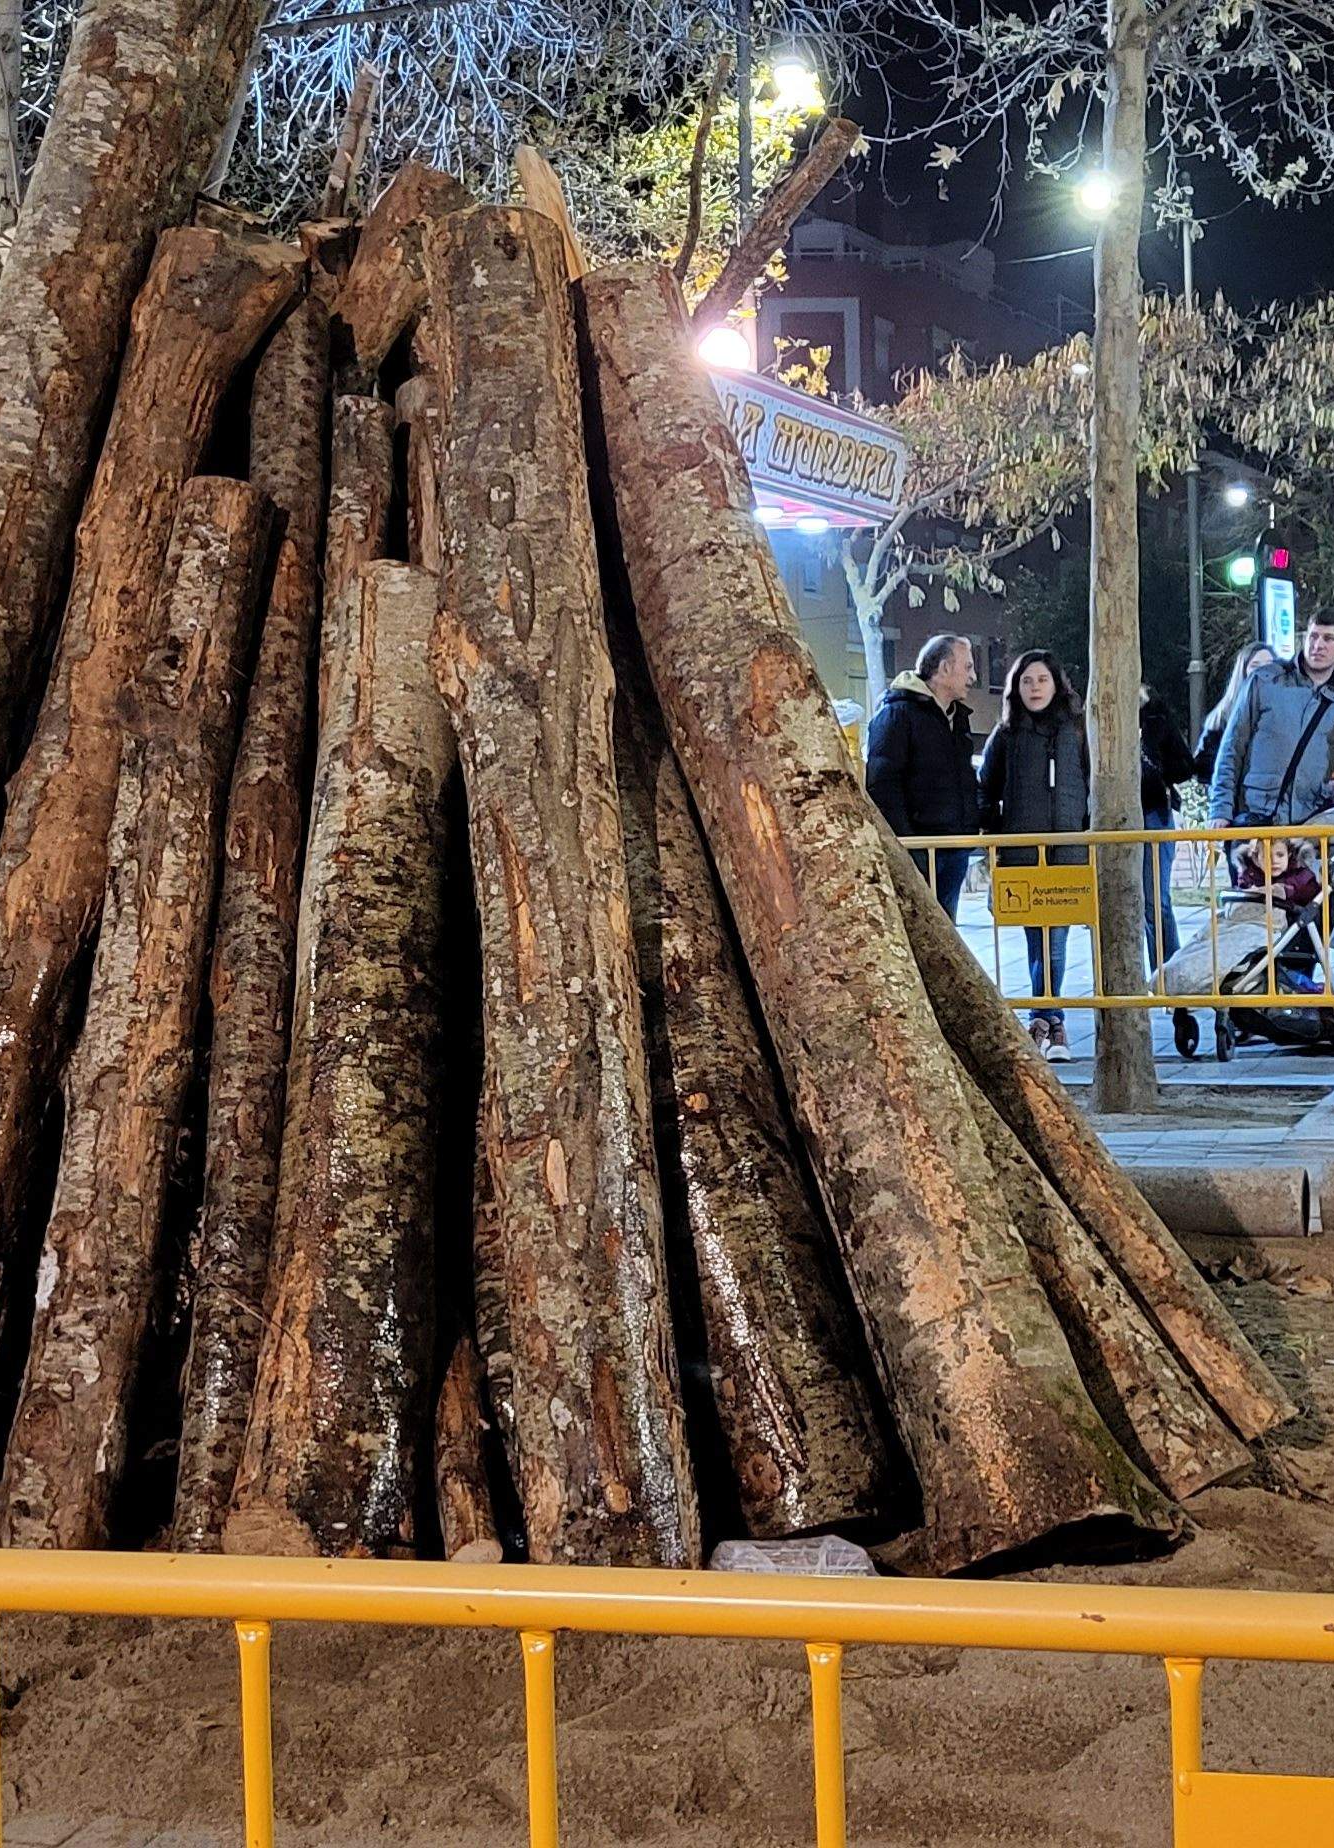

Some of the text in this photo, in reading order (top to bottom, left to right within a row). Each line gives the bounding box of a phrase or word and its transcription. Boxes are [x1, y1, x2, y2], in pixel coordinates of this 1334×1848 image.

[767, 412, 897, 500] MUNDIAL
[1032, 886, 1091, 896] Ayuntamiento
[1032, 897, 1079, 906] de Huesca
